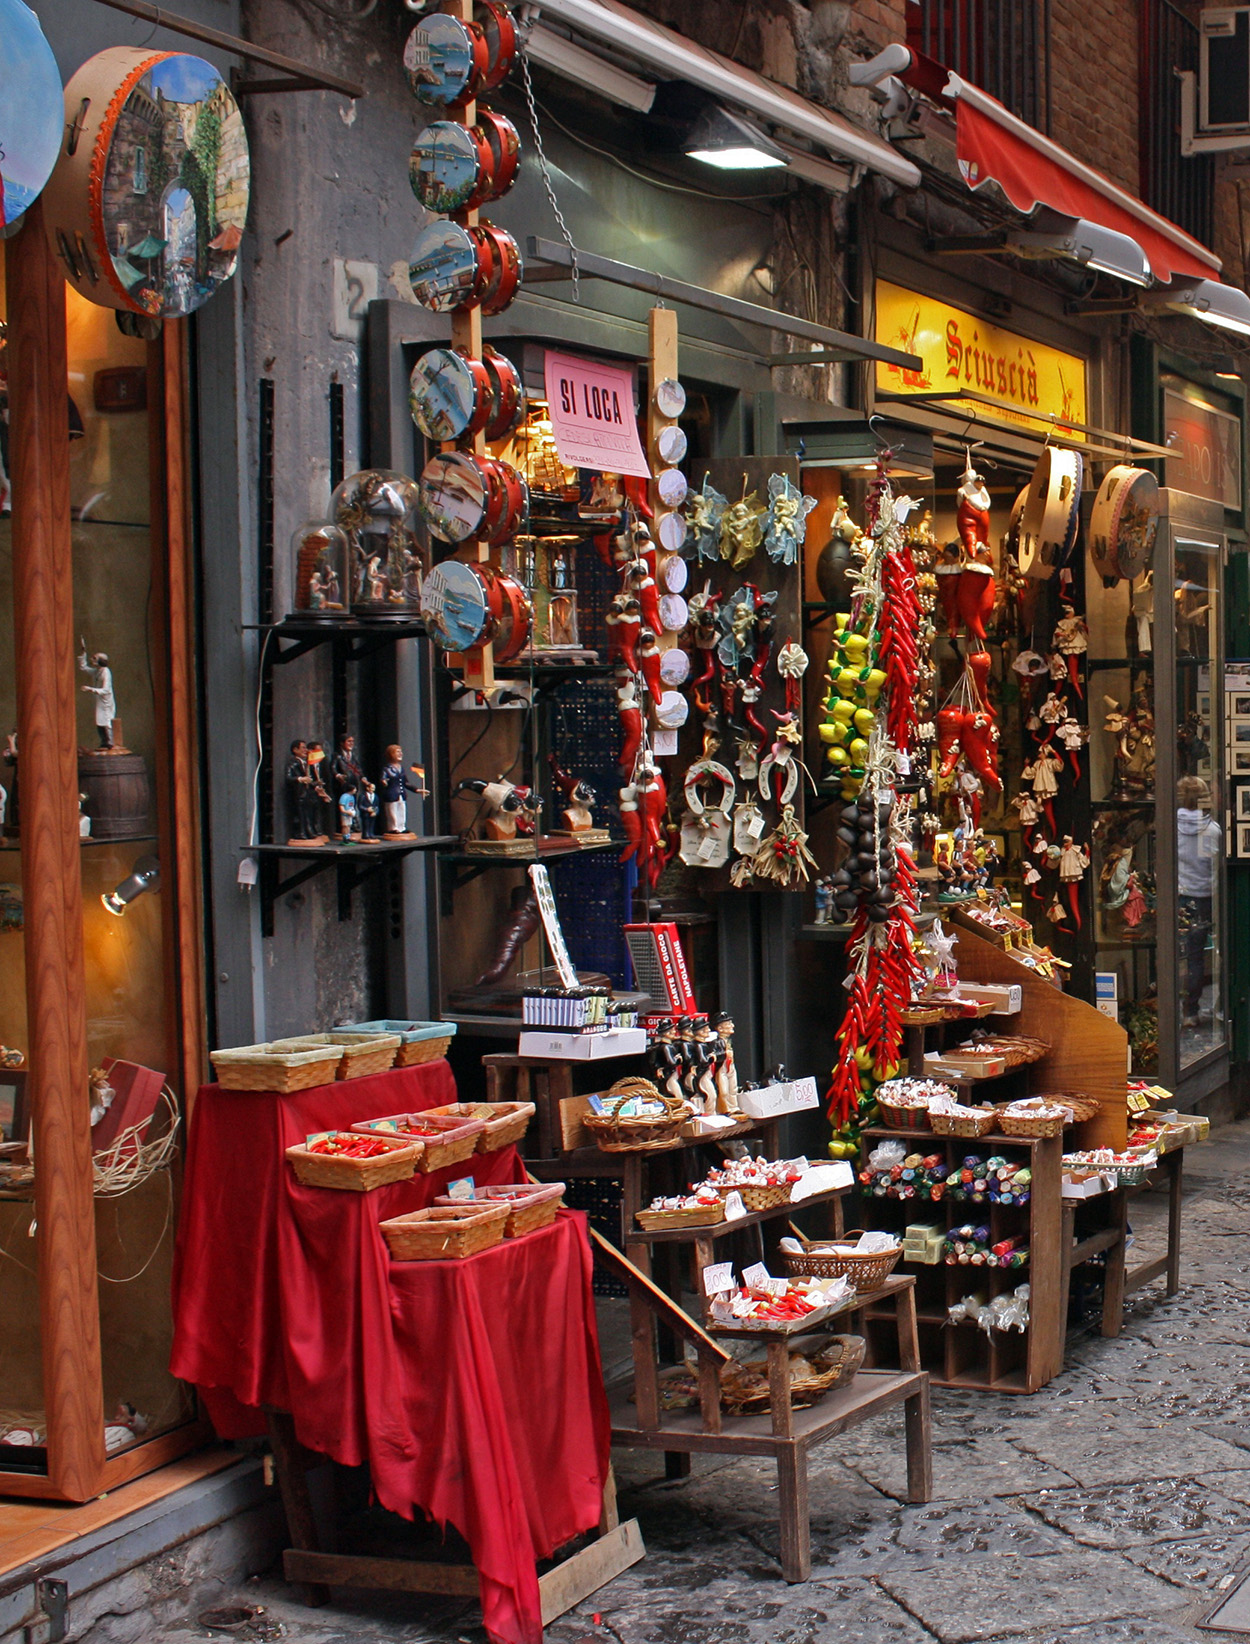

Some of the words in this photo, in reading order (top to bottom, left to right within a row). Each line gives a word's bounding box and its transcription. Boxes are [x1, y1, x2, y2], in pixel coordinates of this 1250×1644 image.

[946, 319, 1039, 405] Sciuscià
[560, 378, 577, 415] SI
[583, 383, 623, 425] LOCA
[657, 933, 670, 962] GIOCO
[665, 963, 673, 976] DA
[673, 940, 692, 998] NAPOLETANE
[668, 977, 680, 1006] CARTE
